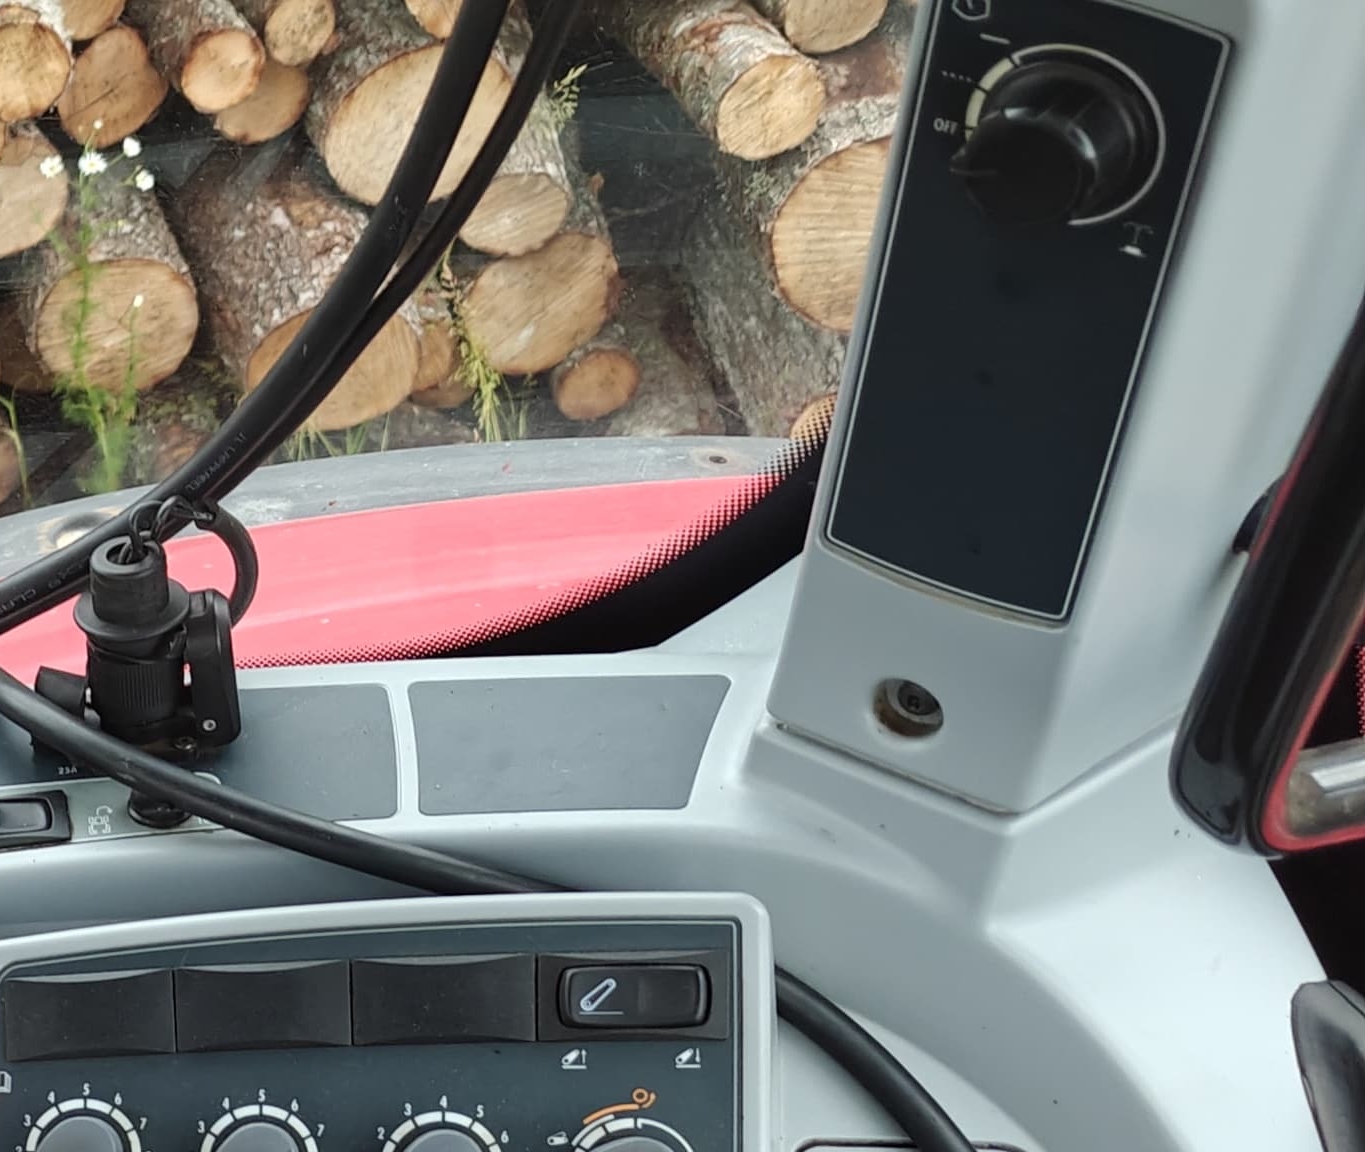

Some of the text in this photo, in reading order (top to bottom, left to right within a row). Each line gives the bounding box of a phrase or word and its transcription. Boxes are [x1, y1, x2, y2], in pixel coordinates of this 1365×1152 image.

[933, 117, 958, 135] OFF
[83, 1083, 90, 1096] 5
[258, 1088, 266, 1102] 5
[47, 1091, 56, 1103] 4
[114, 1092, 123, 1106] 6
[221, 1097, 230, 1110] 4
[439, 1095, 448, 1108] 4
[291, 1098, 299, 1112] 6
[403, 1102, 413, 1116] 3
[476, 1104, 485, 1118] 5
[23, 1114, 31, 1127] 3
[139, 1117, 147, 1130] 7
[197, 1120, 205, 1134] 3
[317, 1124, 325, 1136] 7
[377, 1127, 385, 1140] 2
[501, 1130, 509, 1144] 6
